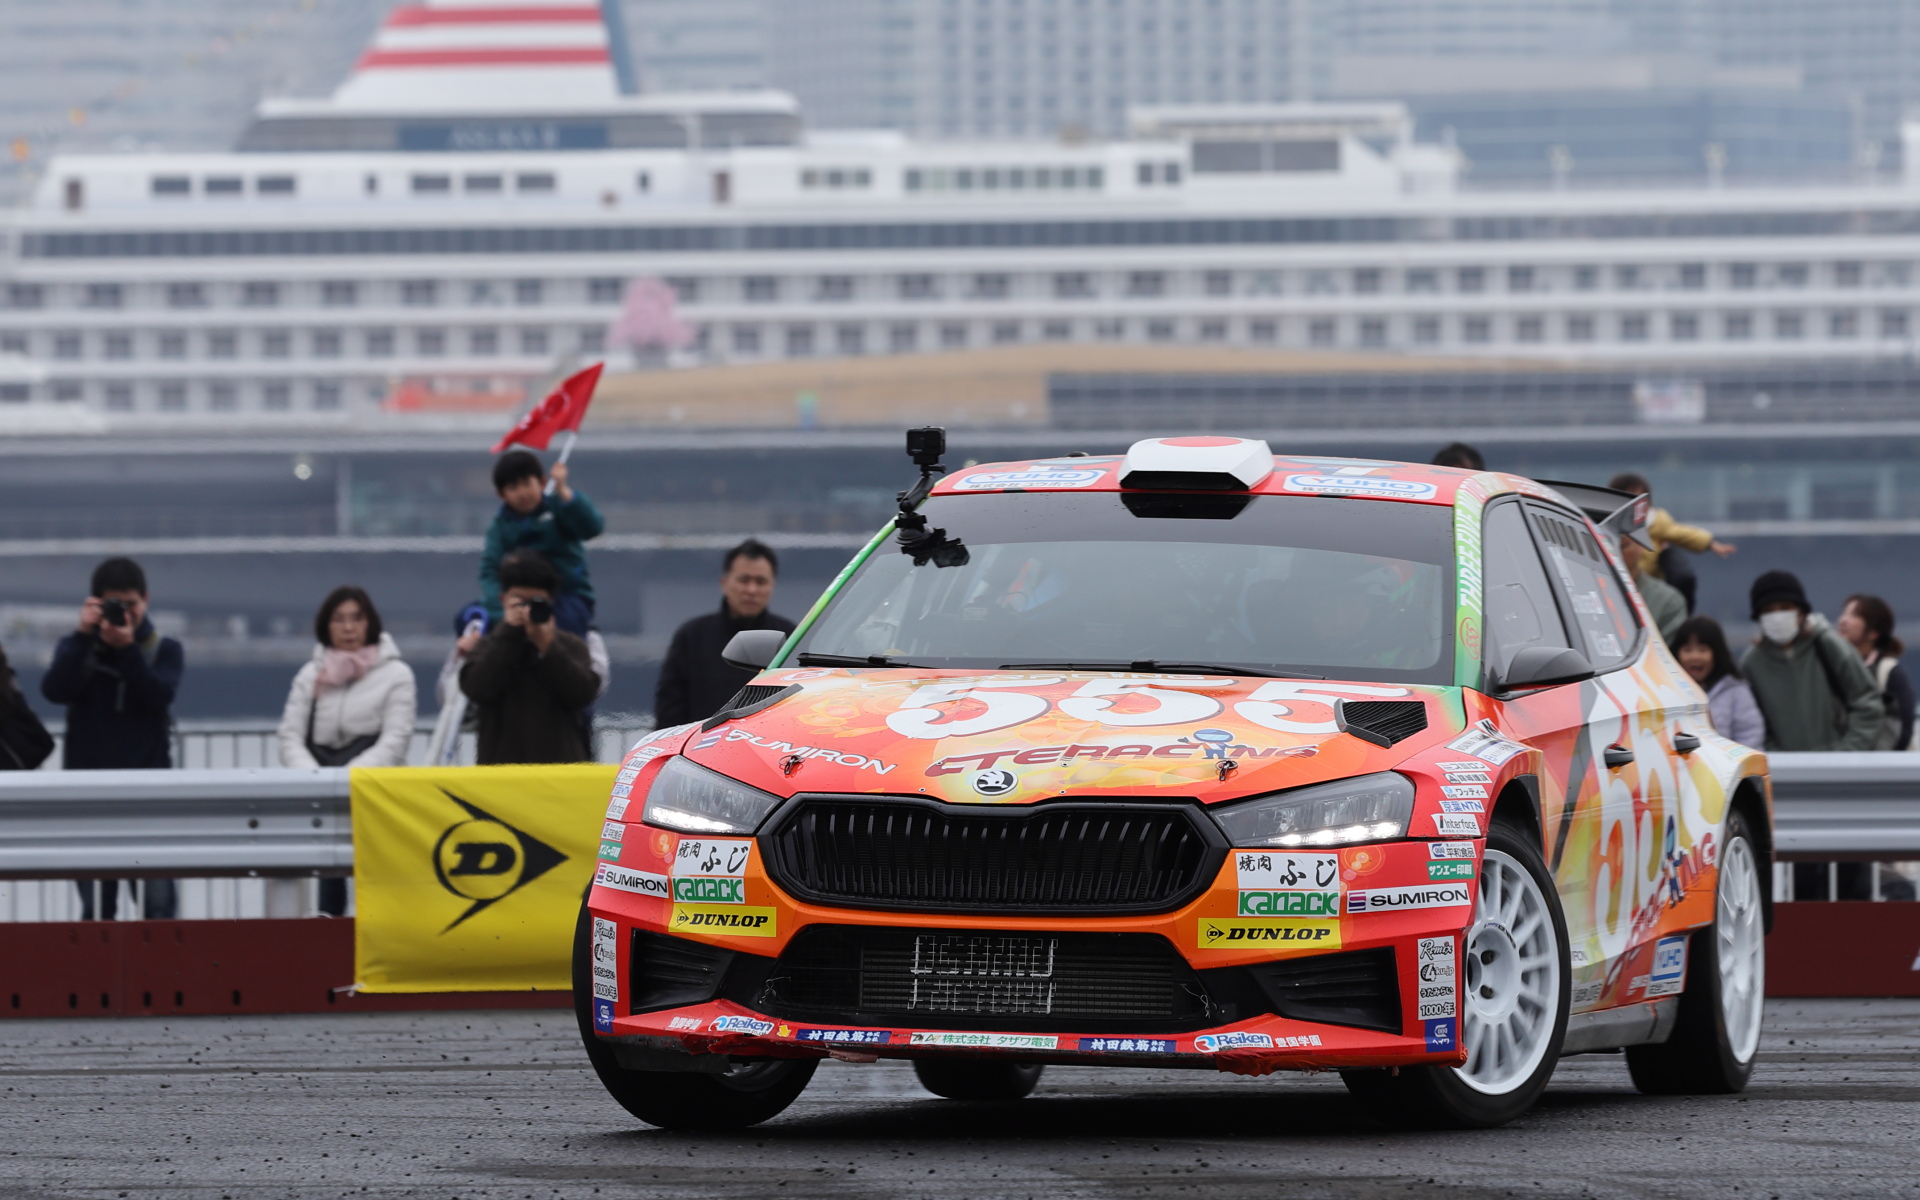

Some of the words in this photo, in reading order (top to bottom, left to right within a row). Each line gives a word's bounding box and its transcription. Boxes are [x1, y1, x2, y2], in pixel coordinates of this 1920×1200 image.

[1310, 477, 1414, 490] YUHO
[1456, 508, 1481, 551] FIVE
[1459, 546, 1482, 616] THREE
[886, 669, 1413, 741] 555
[725, 729, 899, 776] SUMIRON
[449, 842, 516, 876] D
[677, 842, 702, 858] 焼肉
[701, 846, 749, 873] ふじ
[1446, 847, 1476, 858] 平和食品
[1239, 854, 1272, 872] 焼肉
[1280, 859, 1337, 887] ふじ
[1428, 863, 1473, 876] サンエー印刷
[605, 871, 668, 892] SUMIRON
[1370, 889, 1469, 907] SUMIRON
[689, 913, 769, 927] DUNLOP
[1226, 928, 1331, 940] DUNLOP
[1420, 986, 1455, 998] うたみらい
[726, 1017, 773, 1031] Reiken
[808, 1030, 866, 1042] 村田鉄筋
[942, 1034, 992, 1045] 株式会社
[997, 1036, 1056, 1048] タザワ電気
[1217, 1033, 1272, 1046] Reiken
[1274, 1035, 1322, 1048] 豊国学園
[1090, 1038, 1150, 1052] 村田鉄筋
